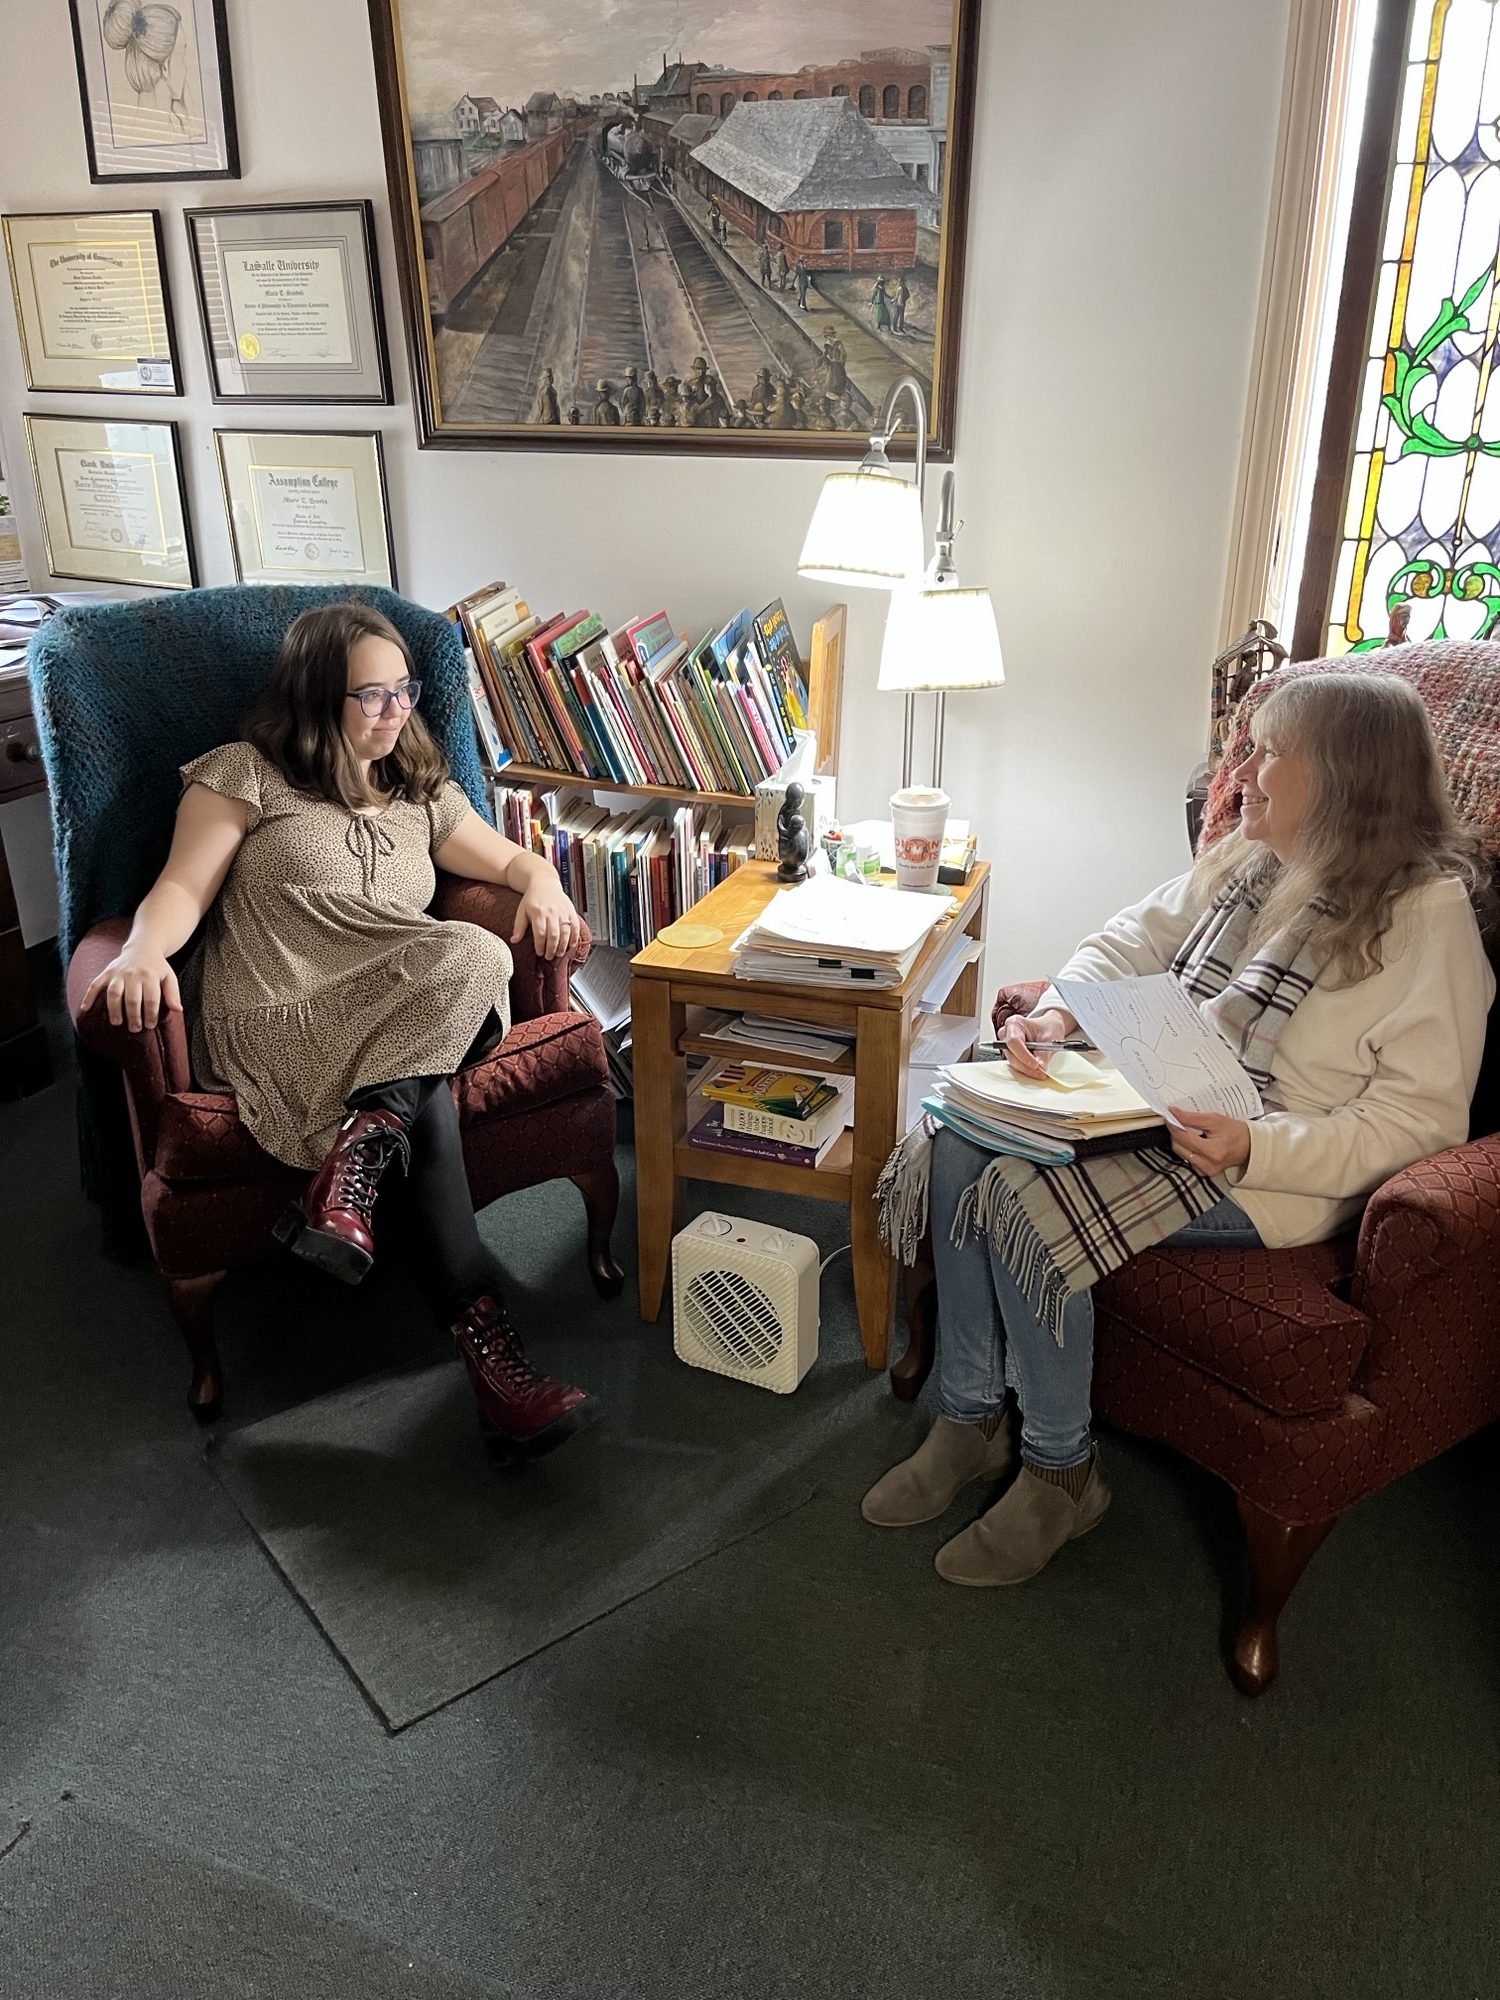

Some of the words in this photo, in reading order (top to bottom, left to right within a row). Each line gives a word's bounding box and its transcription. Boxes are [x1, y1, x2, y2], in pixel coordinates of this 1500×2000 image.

[242, 260, 275, 271] LaSalle
[277, 259, 320, 272] University
[268, 472, 311, 489] Assumption
[311, 474, 339, 490] College
[746, 1112, 755, 1132] things
